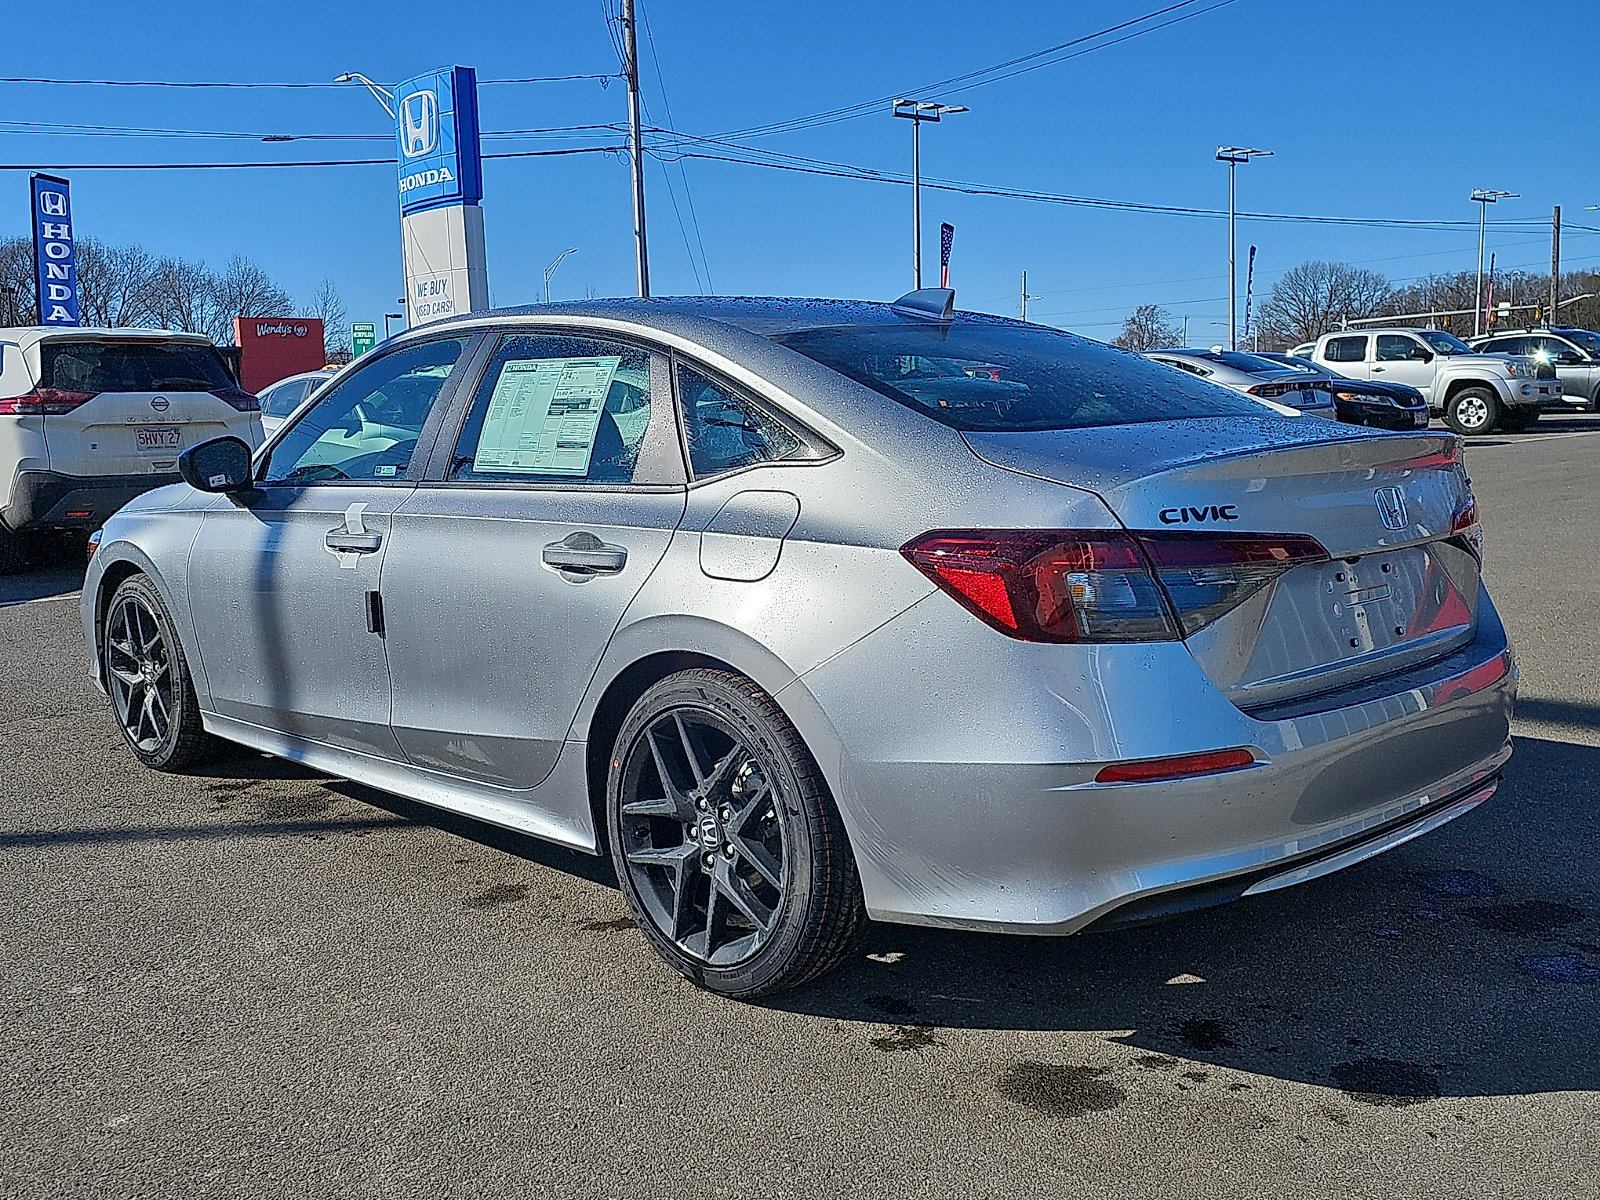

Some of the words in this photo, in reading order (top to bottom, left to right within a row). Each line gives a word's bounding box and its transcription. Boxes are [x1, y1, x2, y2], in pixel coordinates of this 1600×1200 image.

[399, 167, 455, 193] HONDA
[42, 222, 75, 321] HONDA
[417, 281, 428, 298] WE
[430, 278, 448, 296] BUY
[417, 304, 431, 317] USED
[432, 300, 453, 315] CARS!
[257, 322, 292, 337] Wendy's
[138, 433, 165, 445] 5HVY
[168, 432, 181, 445] 27
[1159, 504, 1240, 525] CIVIC
